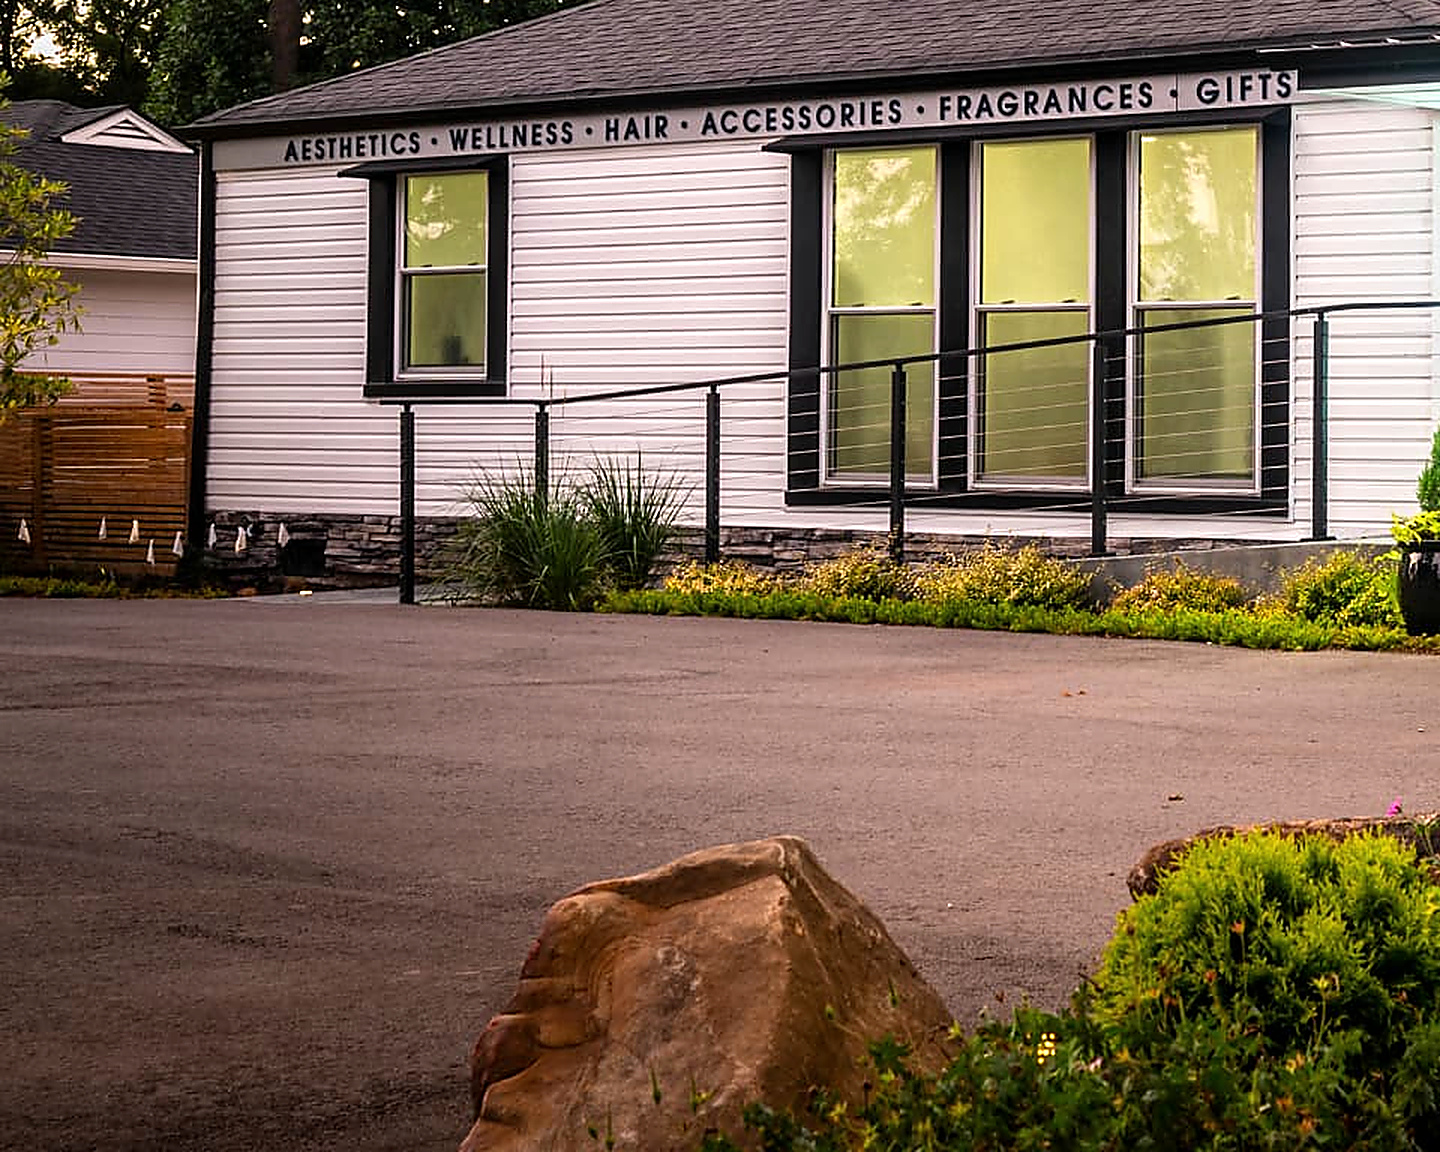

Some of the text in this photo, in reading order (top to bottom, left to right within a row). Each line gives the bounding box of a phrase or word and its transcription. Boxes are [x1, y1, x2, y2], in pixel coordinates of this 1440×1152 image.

[284, 72, 1292, 162] AESTHETICS WELLNESS HAIR ACCESSORIES FRAGRANCES GIFTS
